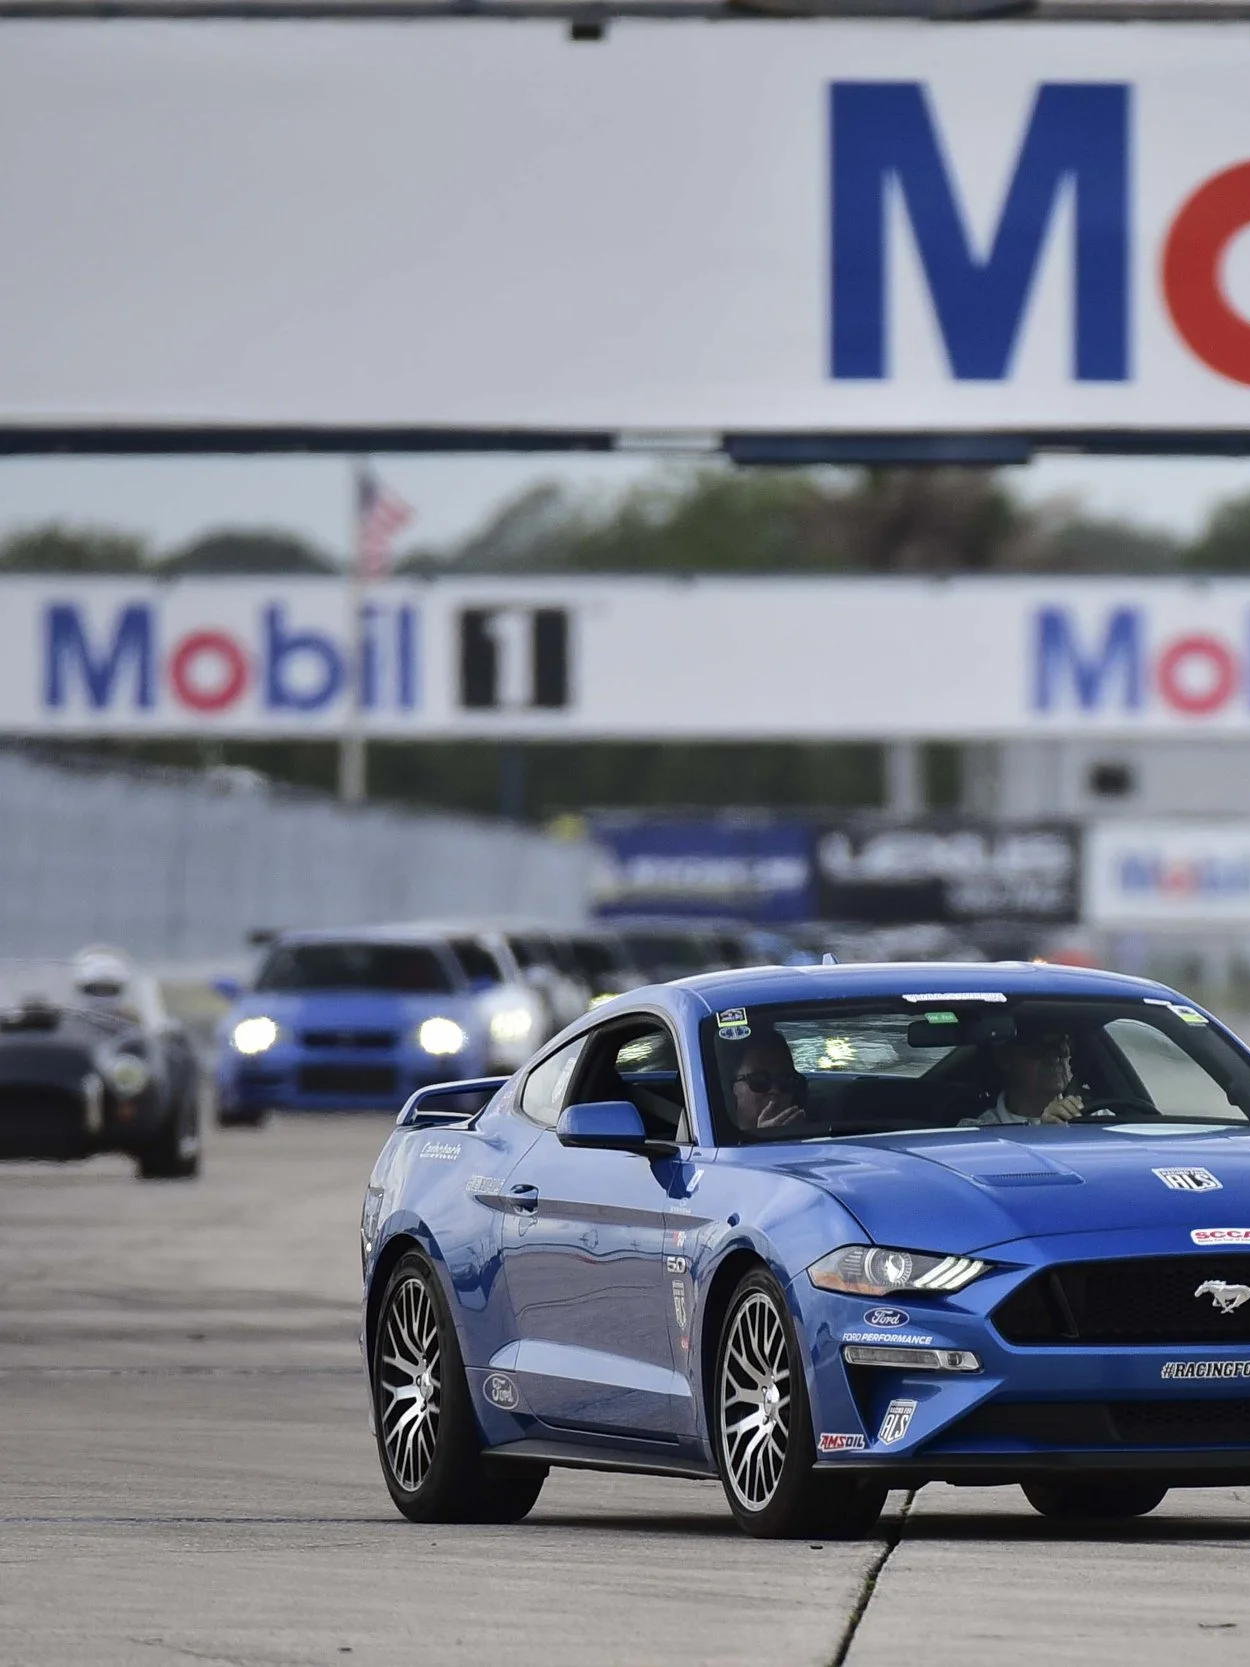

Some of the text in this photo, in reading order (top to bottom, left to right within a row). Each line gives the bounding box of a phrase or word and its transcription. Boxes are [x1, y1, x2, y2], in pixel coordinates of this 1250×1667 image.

[42, 602, 422, 713] Mobil
[1163, 1174, 1219, 1190] ALS
[871, 1310, 900, 1326] Ford
[842, 1332, 933, 1345] FORD PERFORMANCE
[492, 1377, 515, 1403] Ford
[880, 1413, 910, 1442] ALS
[820, 1434, 865, 1449] AMSOIL
